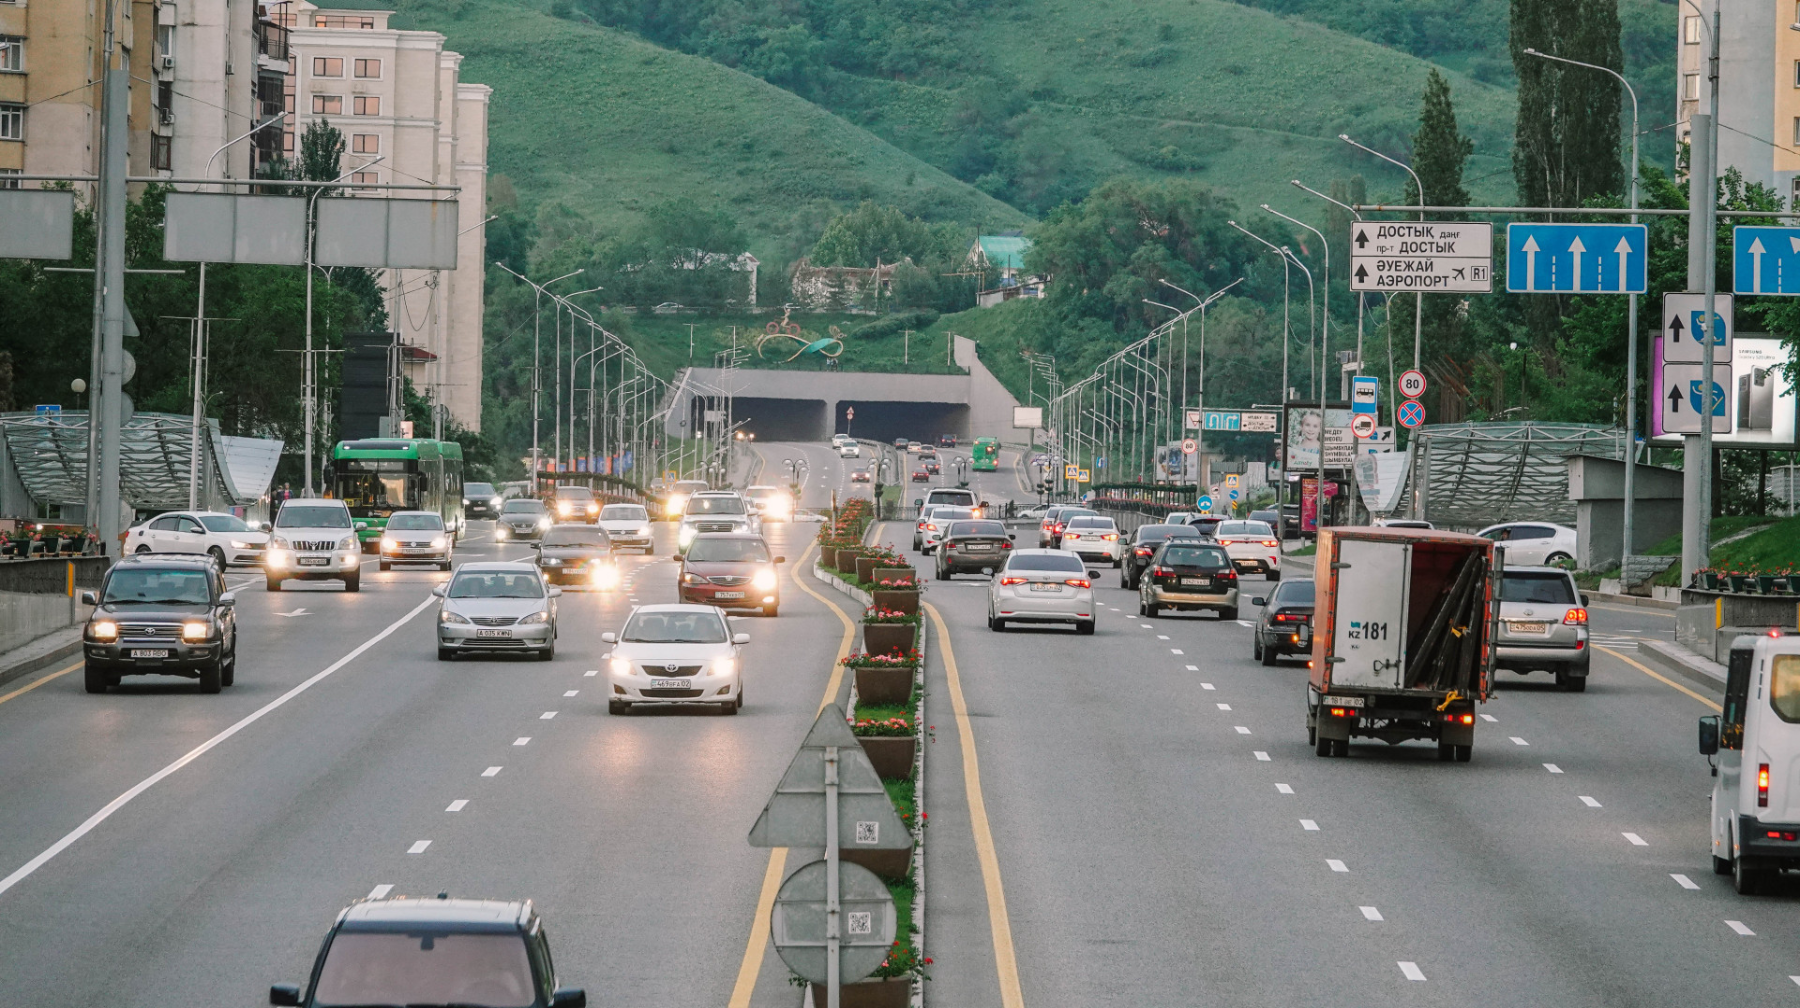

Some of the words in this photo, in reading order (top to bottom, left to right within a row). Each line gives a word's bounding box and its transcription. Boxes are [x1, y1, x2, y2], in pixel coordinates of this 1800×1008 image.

[1377, 226, 1434, 239] ДОСТЫҚ
[1377, 245, 1394, 254] пр-т
[1399, 242, 1456, 254] ДОСТЫК
[1376, 258, 1434, 272] ӘУЕЖАЙ
[1473, 268, 1485, 280] R1
[1377, 275, 1450, 287] АЭРОПОРТ
[1406, 379, 1419, 389] 80
[1348, 630, 1361, 639] KZ
[1362, 621, 1387, 640] 181
